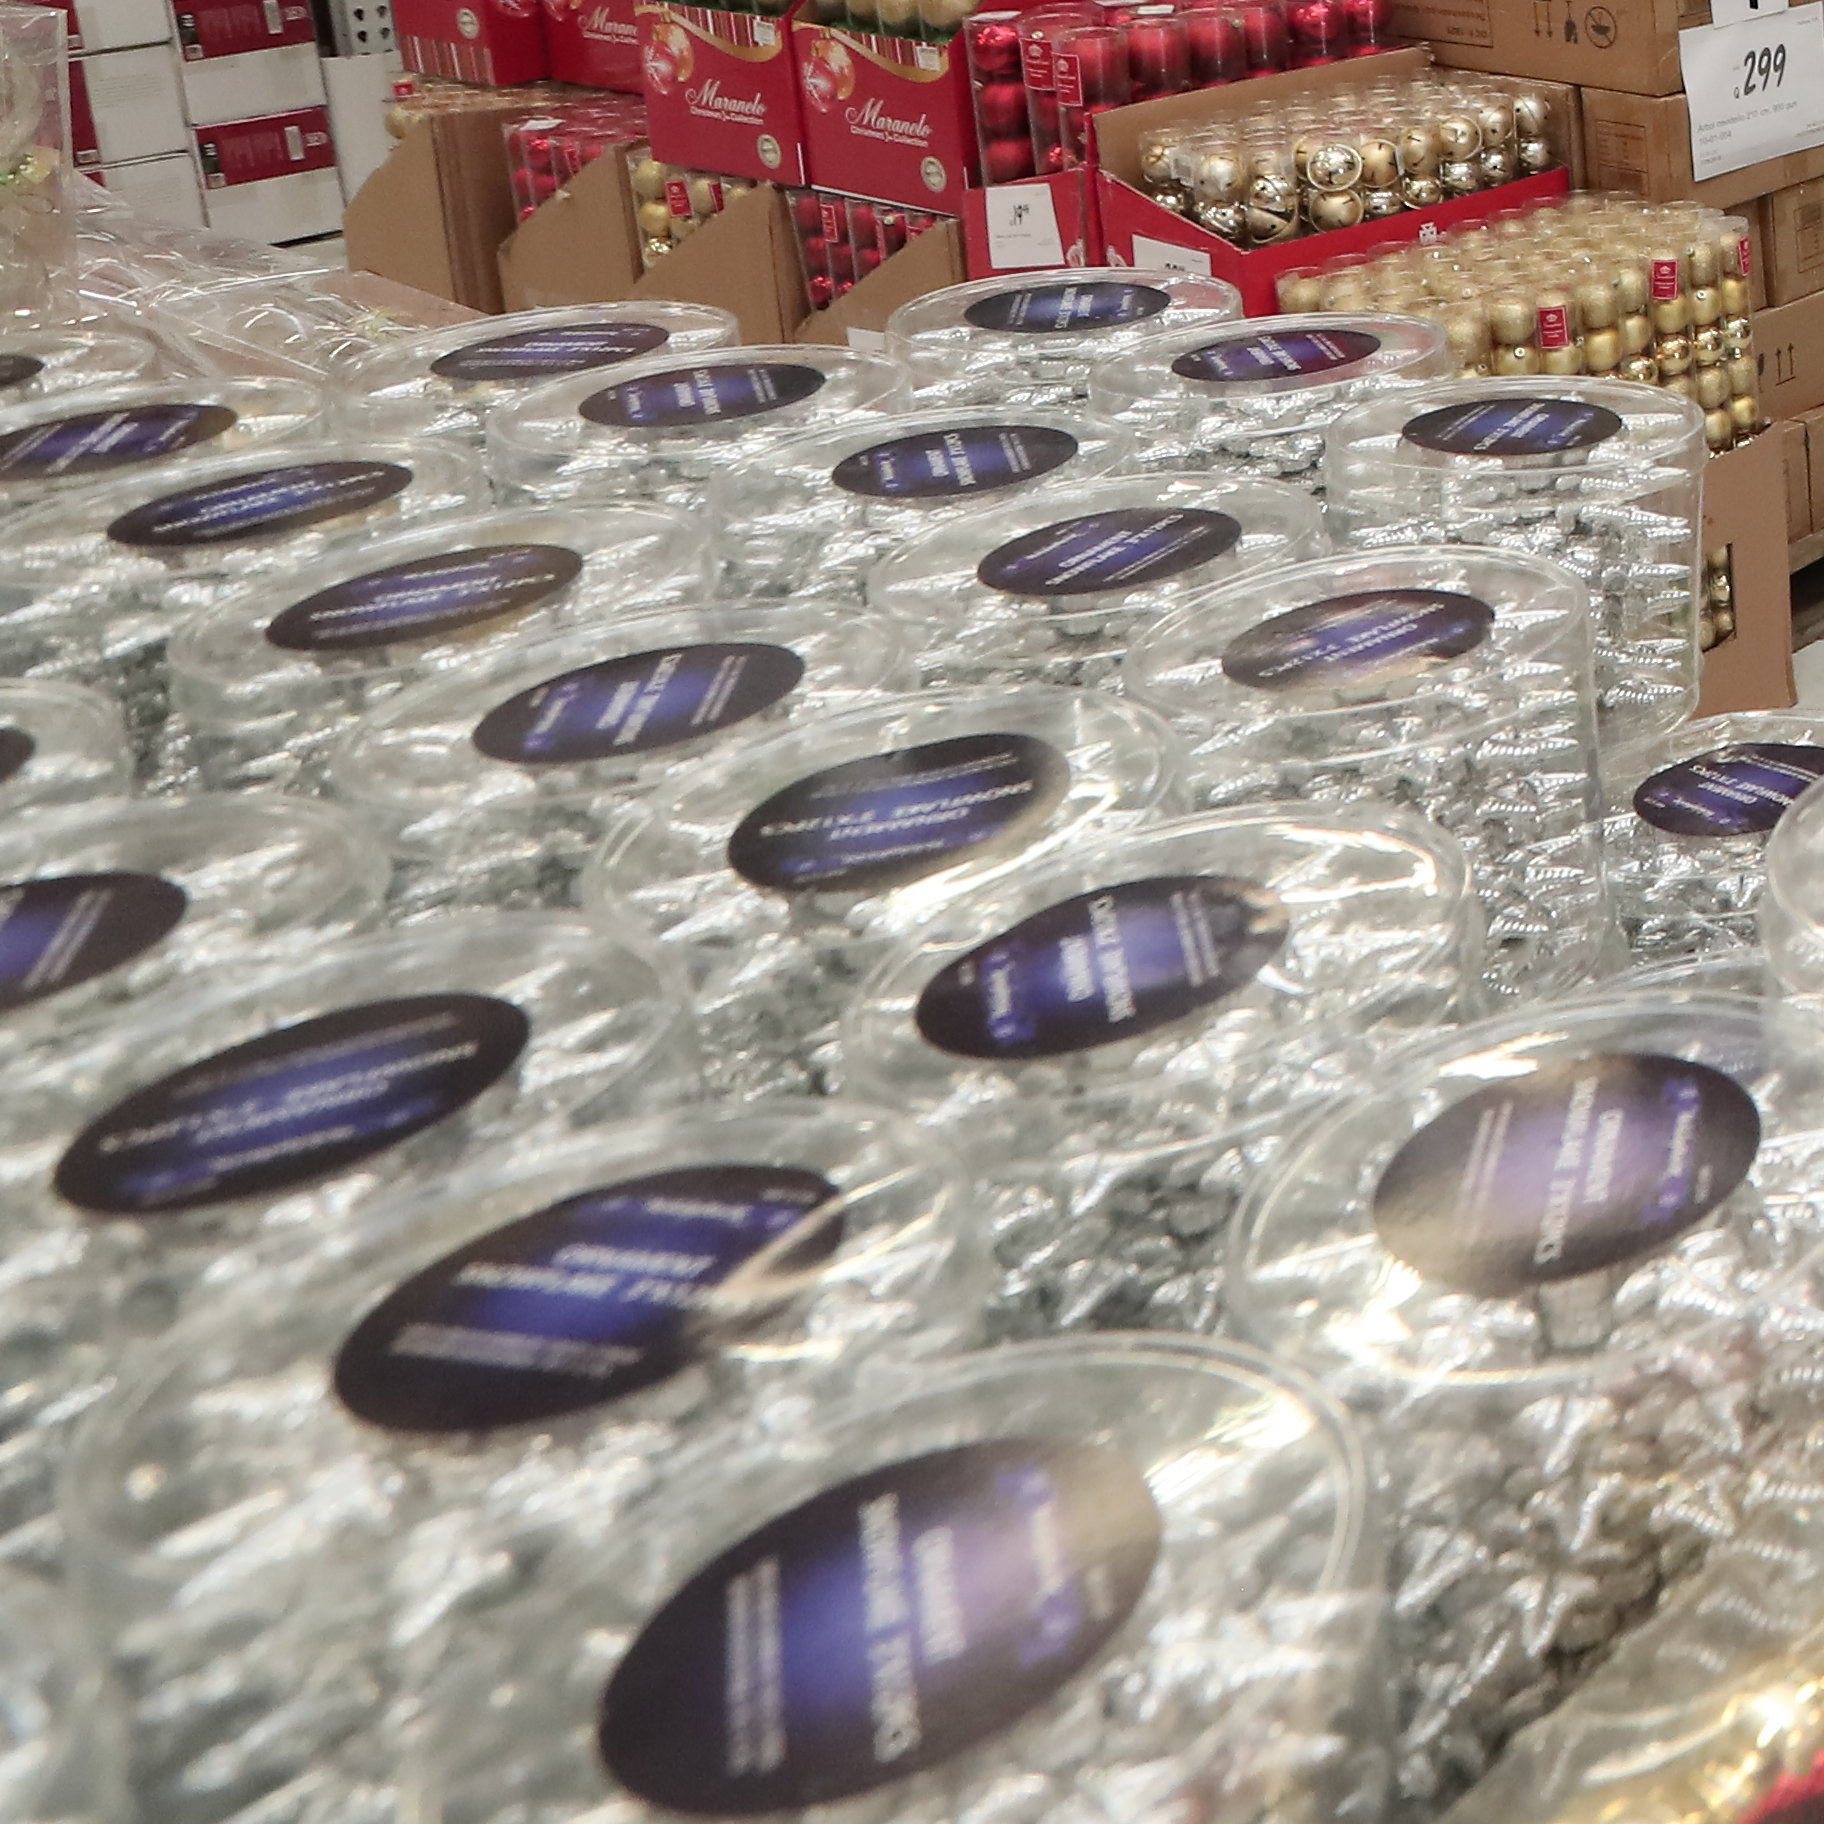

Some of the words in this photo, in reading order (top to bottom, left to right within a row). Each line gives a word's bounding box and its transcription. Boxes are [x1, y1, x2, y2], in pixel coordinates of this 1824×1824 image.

[1743, 43, 1787, 97] 299
[685, 79, 769, 116] Maranelo
[845, 98, 933, 139] Maranelo
[1735, 782, 1797, 808] NOWFLAKE
